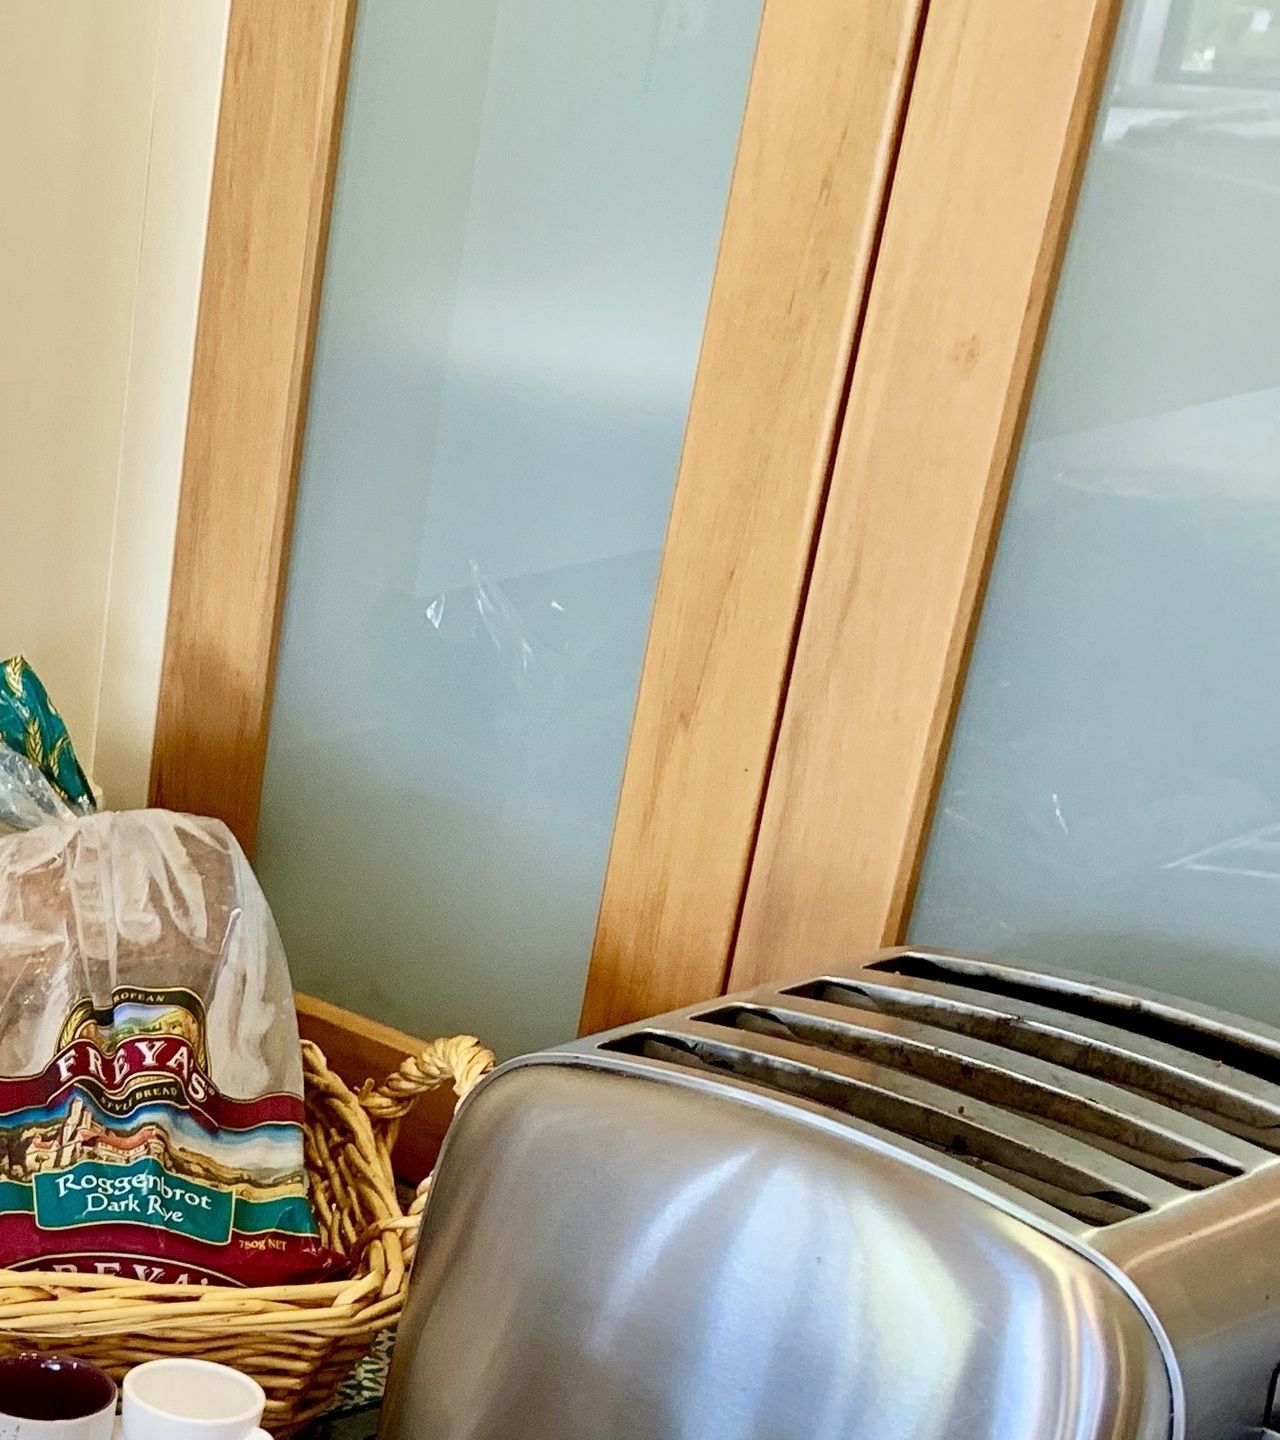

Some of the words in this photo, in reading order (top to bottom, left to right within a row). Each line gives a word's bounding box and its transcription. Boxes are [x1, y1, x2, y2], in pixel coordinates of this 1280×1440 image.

[113, 991, 166, 1003] ROPEAN
[134, 1086, 178, 1101] BREAD
[55, 1171, 212, 1211] Roggenbrot
[82, 1193, 140, 1217] Dark
[146, 1196, 184, 1223] Rye
[268, 1238, 288, 1251] NET
